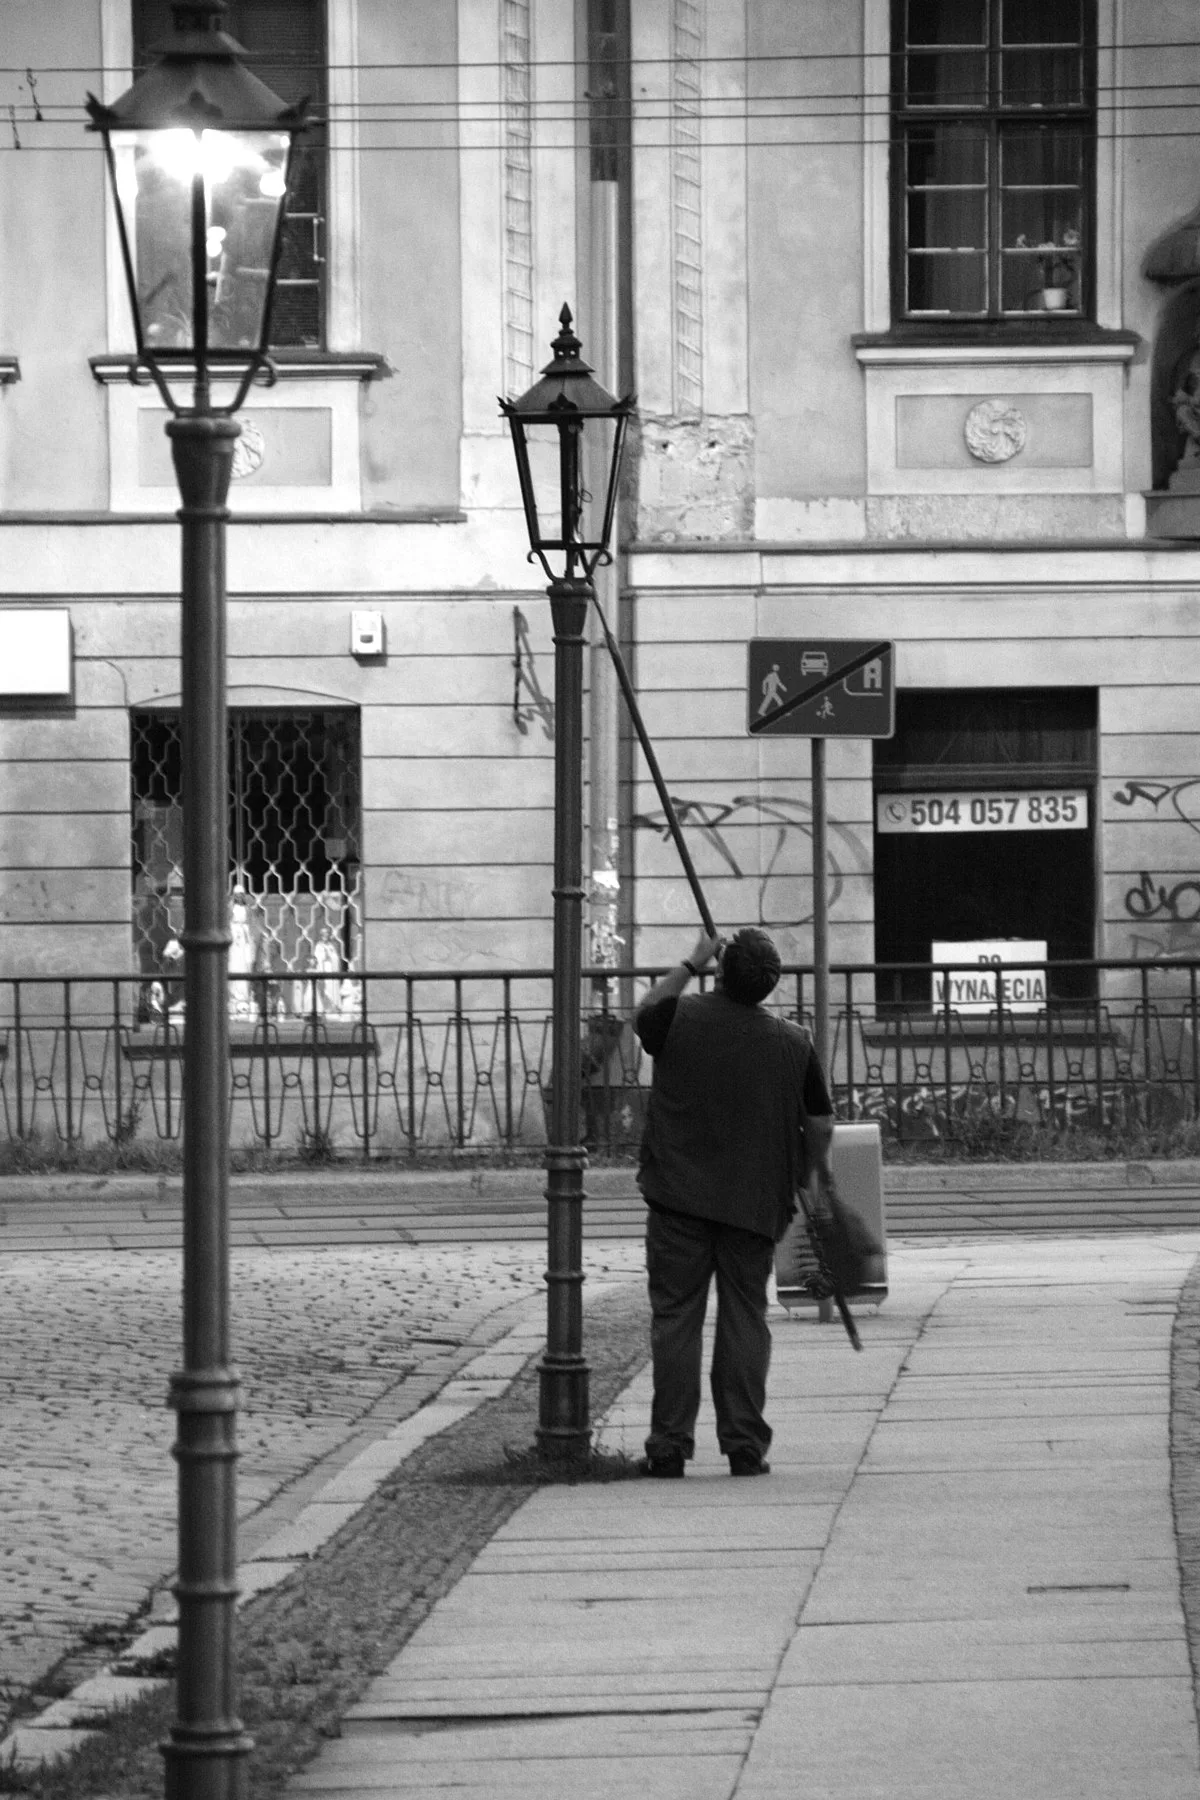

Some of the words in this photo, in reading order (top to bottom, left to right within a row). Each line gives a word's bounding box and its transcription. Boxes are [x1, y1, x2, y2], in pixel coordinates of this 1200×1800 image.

[911, 799, 961, 825] 504
[970, 798, 1020, 824] 057
[1028, 796, 1078, 823] 835
